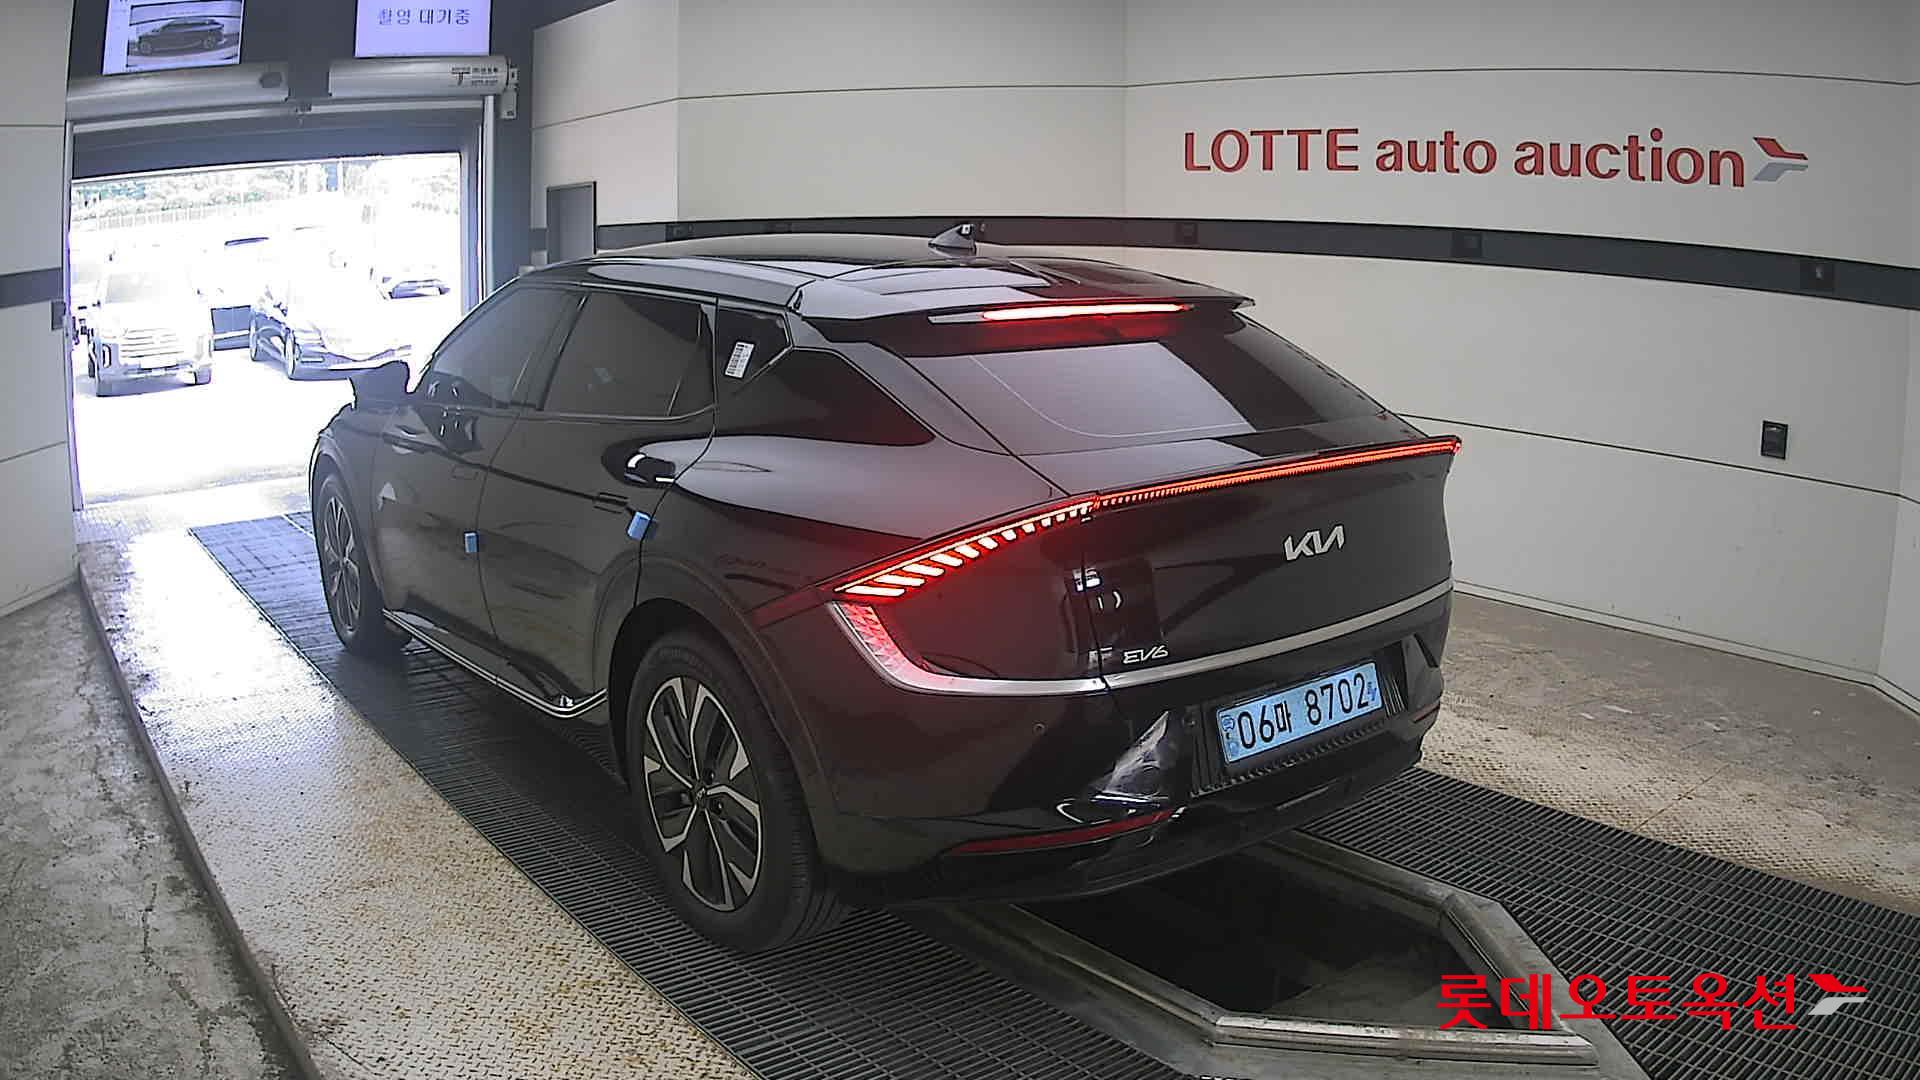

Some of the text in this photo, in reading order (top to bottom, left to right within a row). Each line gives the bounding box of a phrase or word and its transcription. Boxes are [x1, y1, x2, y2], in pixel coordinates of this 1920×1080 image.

[419, 8, 470, 25] 대기중
[1184, 127, 1746, 188] LOTTE auto auction
[1123, 645, 1169, 664] EV6
[1237, 700, 1292, 749] 06마
[1304, 672, 1369, 726] 8702
